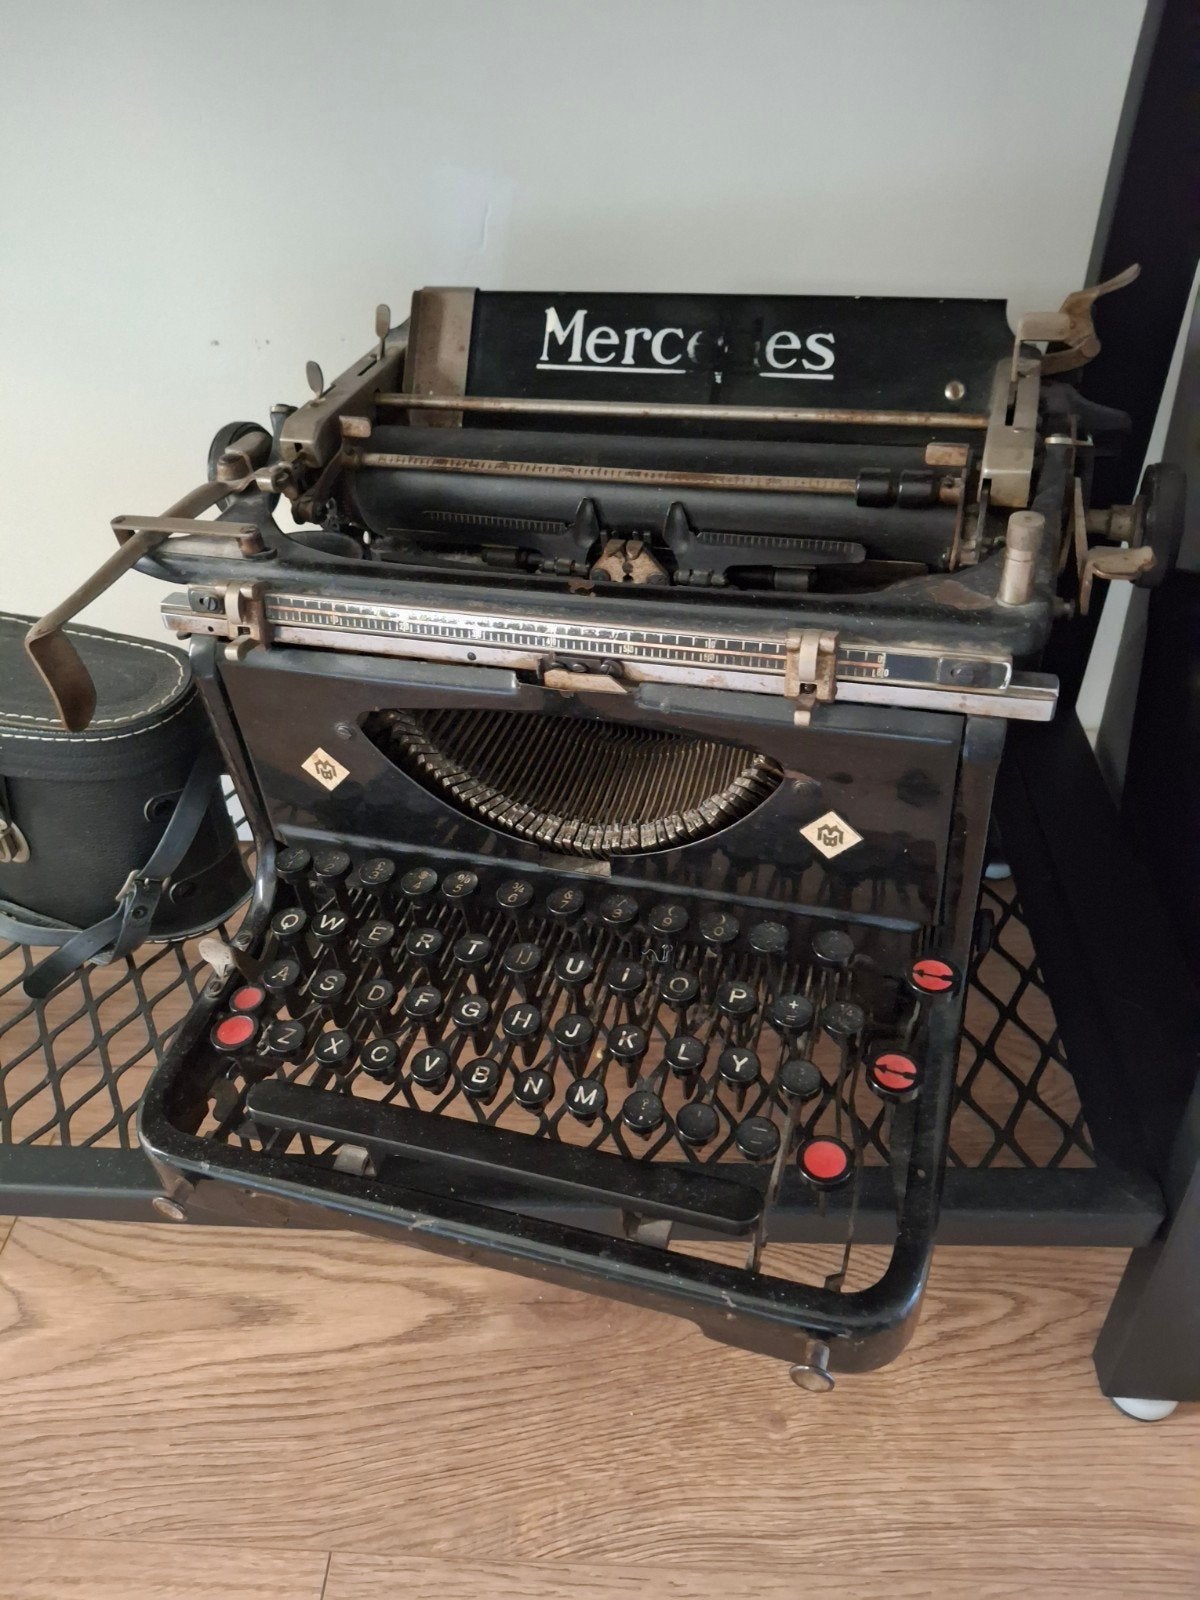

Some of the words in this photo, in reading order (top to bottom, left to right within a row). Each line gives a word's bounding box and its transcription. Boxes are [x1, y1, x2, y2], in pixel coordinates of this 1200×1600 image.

[540, 307, 835, 371] Merces
[452, 884, 464, 893] 5
[508, 893, 519, 903] 6
[280, 914, 299, 930] Q
[320, 914, 345, 931] W
[368, 926, 387, 941] E
[416, 933, 435, 949] R
[468, 939, 484, 955] T
[565, 957, 585, 975] U
[669, 977, 689, 993] O
[729, 988, 747, 1003] P
[271, 965, 289, 981] A
[319, 975, 338, 991] S
[367, 985, 385, 1001] D
[415, 992, 434, 1007] F
[461, 1001, 482, 1018] G
[511, 1010, 533, 1028] H
[564, 1023, 581, 1038] J
[618, 1030, 638, 1049] K
[677, 1043, 690, 1061] L
[732, 1054, 748, 1072] Y
[277, 1028, 297, 1044] Z
[324, 1037, 343, 1055] X
[370, 1045, 389, 1062] C
[425, 1054, 441, 1072] V
[471, 1066, 491, 1083] B
[523, 1076, 544, 1095] N
[574, 1085, 598, 1106] M
